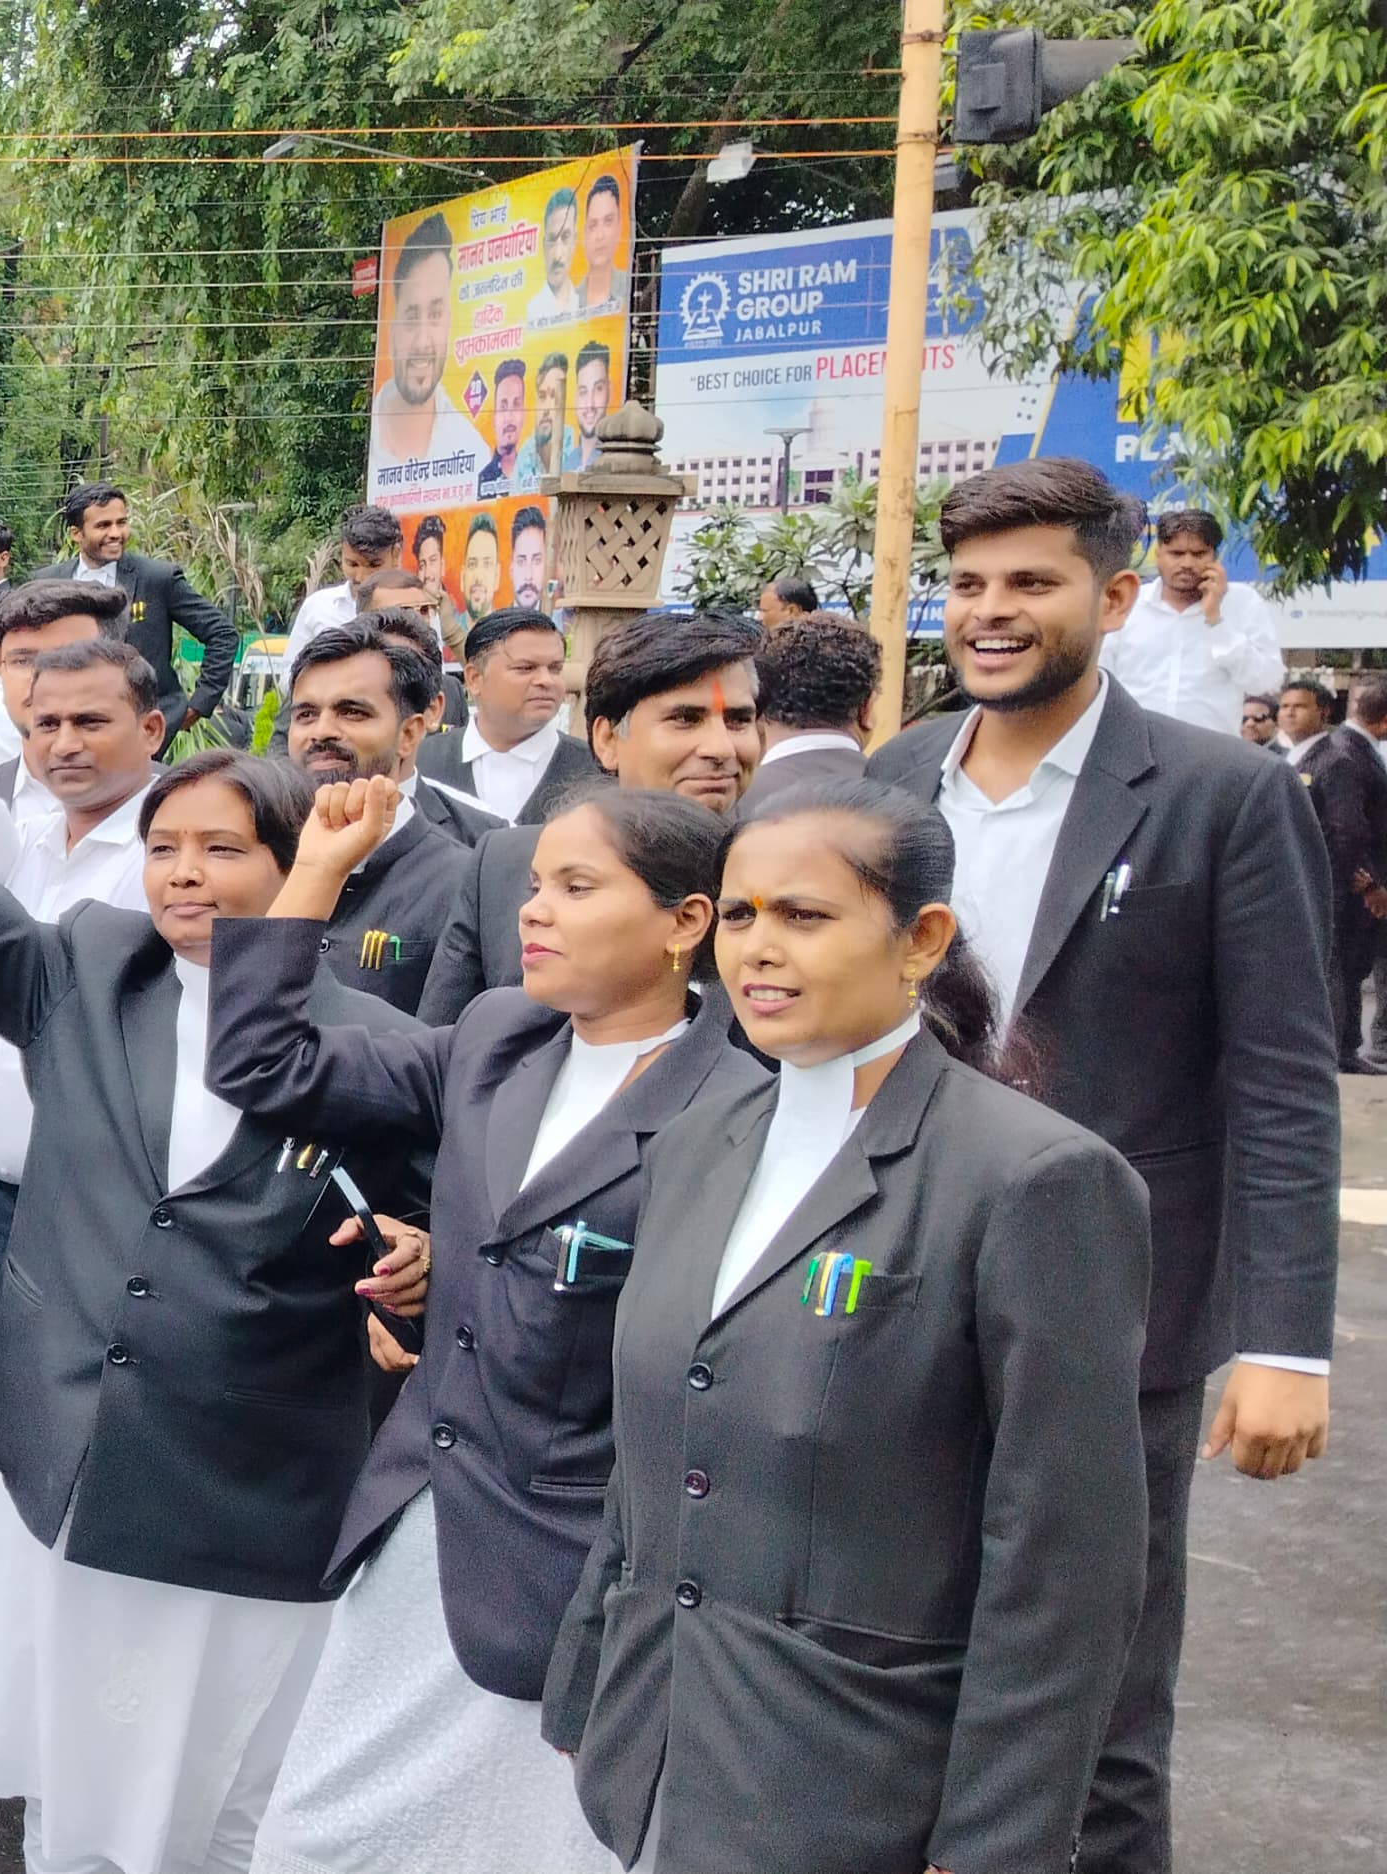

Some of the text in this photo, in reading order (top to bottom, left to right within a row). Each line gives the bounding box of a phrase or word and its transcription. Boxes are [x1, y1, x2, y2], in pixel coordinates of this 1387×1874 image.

[458, 241, 485, 270] मानव
[737, 258, 857, 295] SHRI RAM
[735, 290, 824, 321] GROUP
[734, 319, 822, 342] JABALPUR
[733, 367, 782, 388] CHOICE
[785, 365, 812, 382] FOR
[377, 466, 403, 486] मानव
